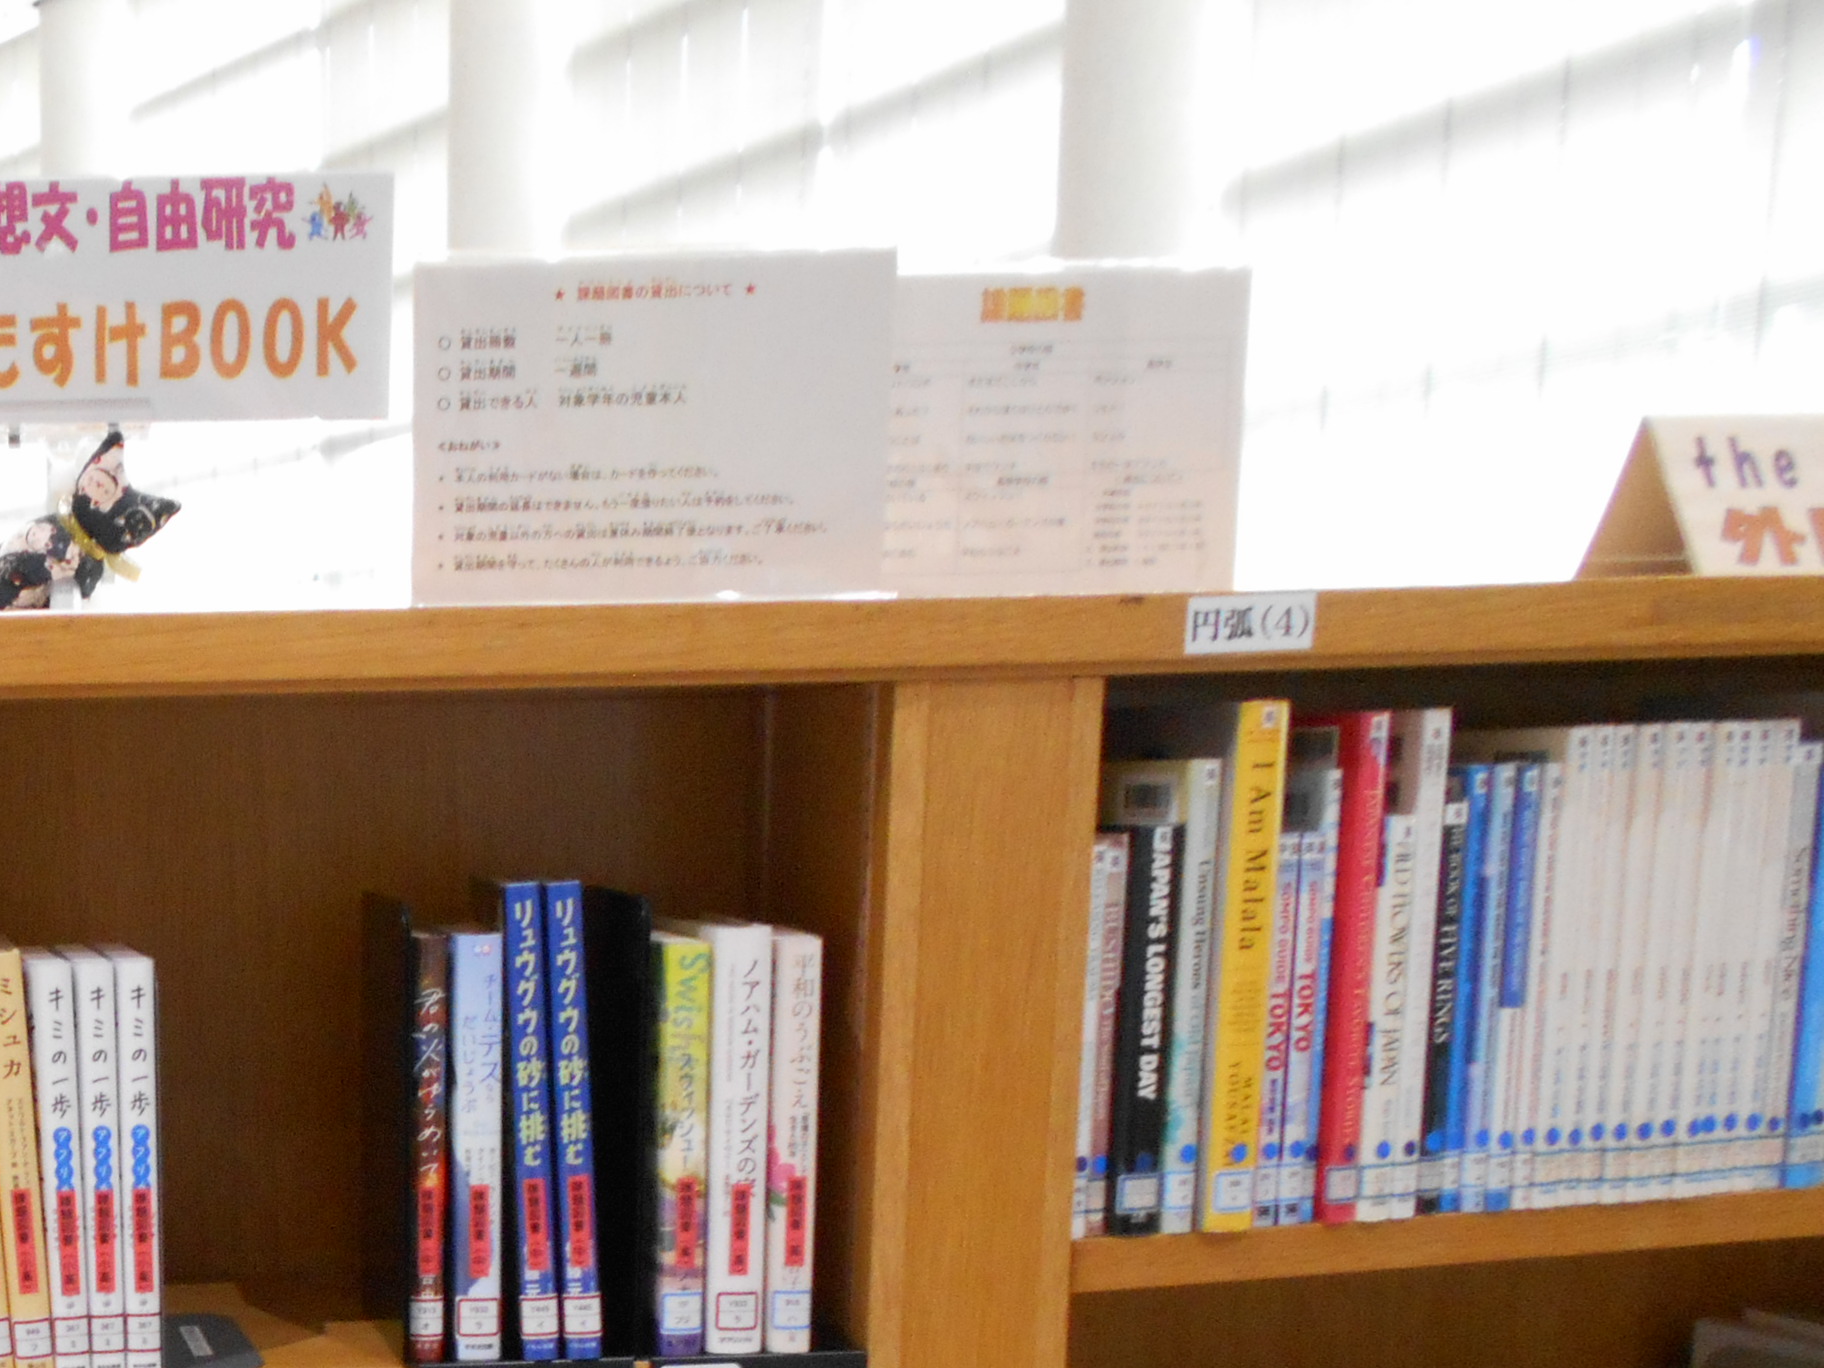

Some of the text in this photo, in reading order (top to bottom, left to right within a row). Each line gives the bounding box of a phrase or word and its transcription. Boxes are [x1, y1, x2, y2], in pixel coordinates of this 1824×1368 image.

[1694, 435, 1799, 489] the
[1247, 785, 1273, 835] Am
[1238, 849, 1269, 951] Malala
[513, 898, 548, 1168] リュウグウの砂に挑む
[554, 897, 591, 1167] リュウグウの砂に挑む
[1139, 942, 1169, 1050] LONGEST
[1265, 989, 1291, 1072] TOKYO
[1293, 971, 1317, 1054] TOKYO
[48, 986, 74, 1120] キミの一歩
[88, 985, 113, 1119] キミの一歩
[129, 984, 152, 1118] キミの一歩
[1136, 1052, 1160, 1102] DAY
